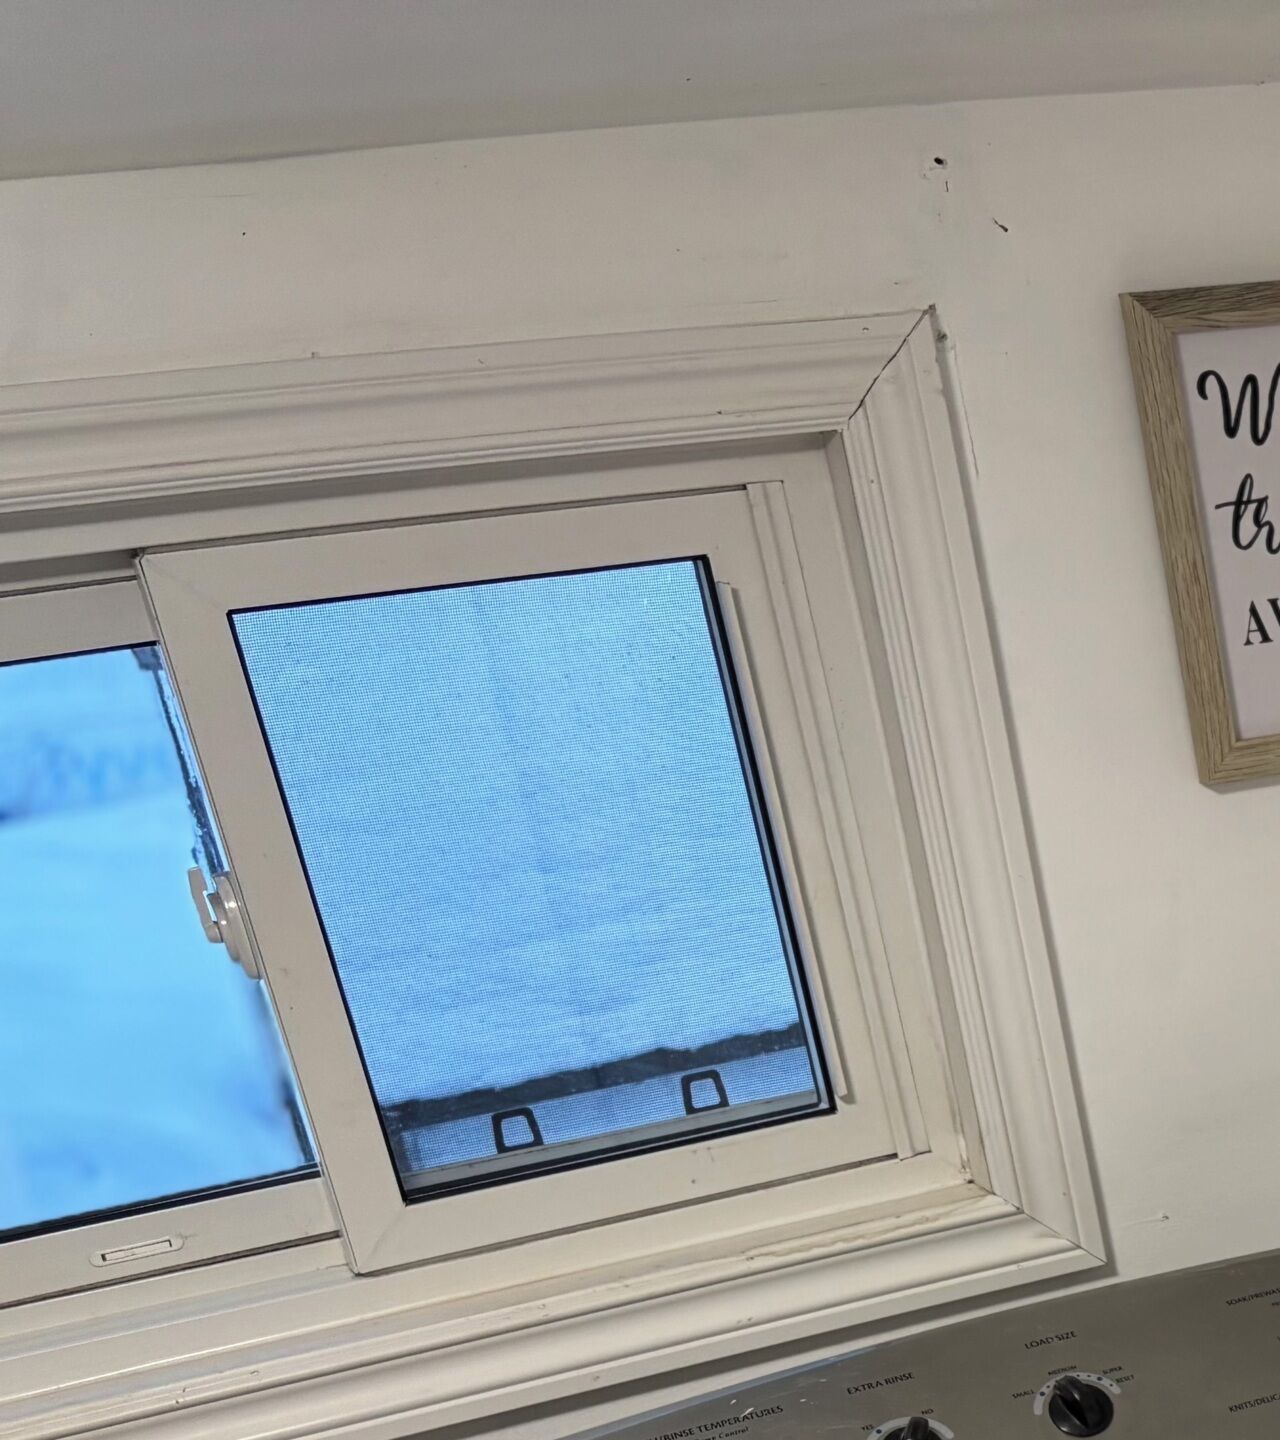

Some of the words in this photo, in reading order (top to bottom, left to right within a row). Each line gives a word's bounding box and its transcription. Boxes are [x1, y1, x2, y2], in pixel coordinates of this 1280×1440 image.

[1024, 1336, 1055, 1350] LOAD
[1055, 1330, 1078, 1342] SIZE
[846, 1379, 884, 1396] EXTRA
[884, 1371, 915, 1386] RINSE
[697, 1404, 784, 1434] TEMPERATURES
[718, 1426, 750, 1440] Control
